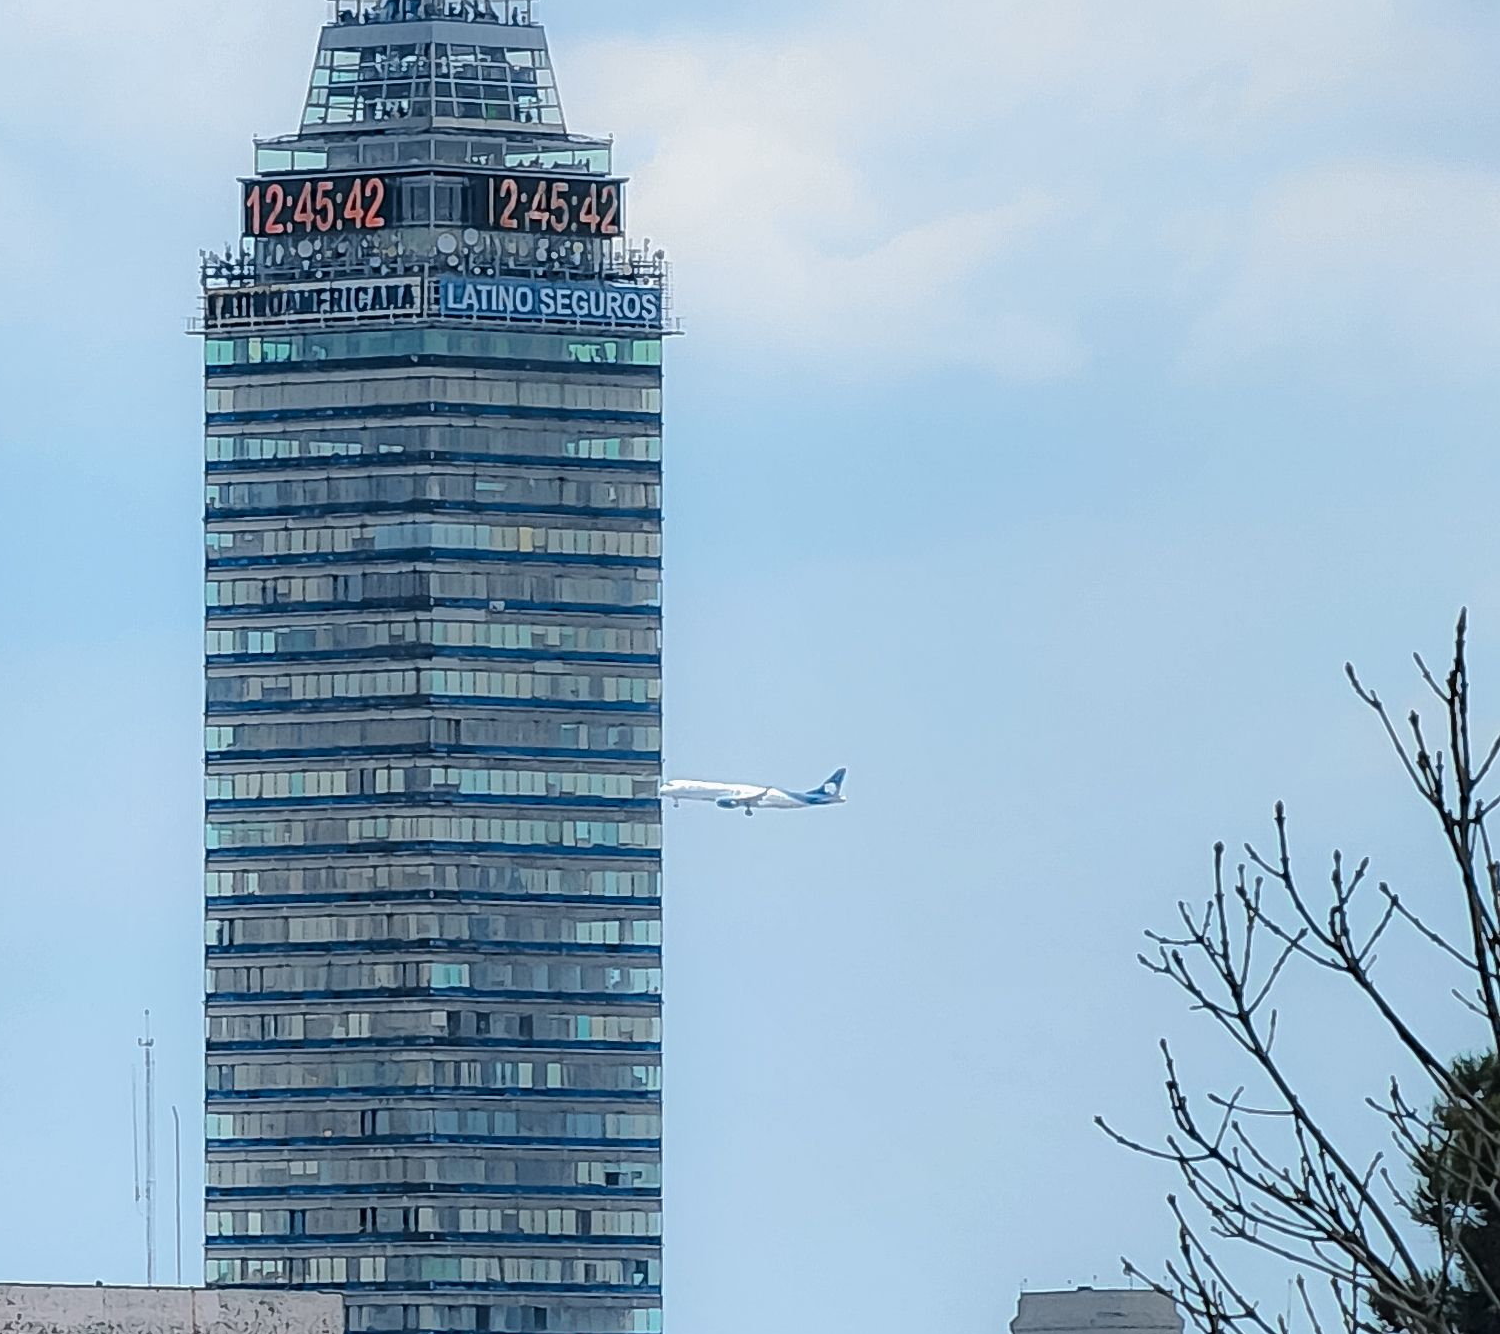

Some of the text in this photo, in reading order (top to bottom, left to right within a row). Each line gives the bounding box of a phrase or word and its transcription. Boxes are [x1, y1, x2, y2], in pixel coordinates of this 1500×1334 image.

[246, 177, 386, 236] 12:45:42
[488, 177, 619, 235] 12:45:42
[207, 283, 414, 318] ATIOAMERICAA
[446, 282, 658, 319] LATINO SEGUROS
